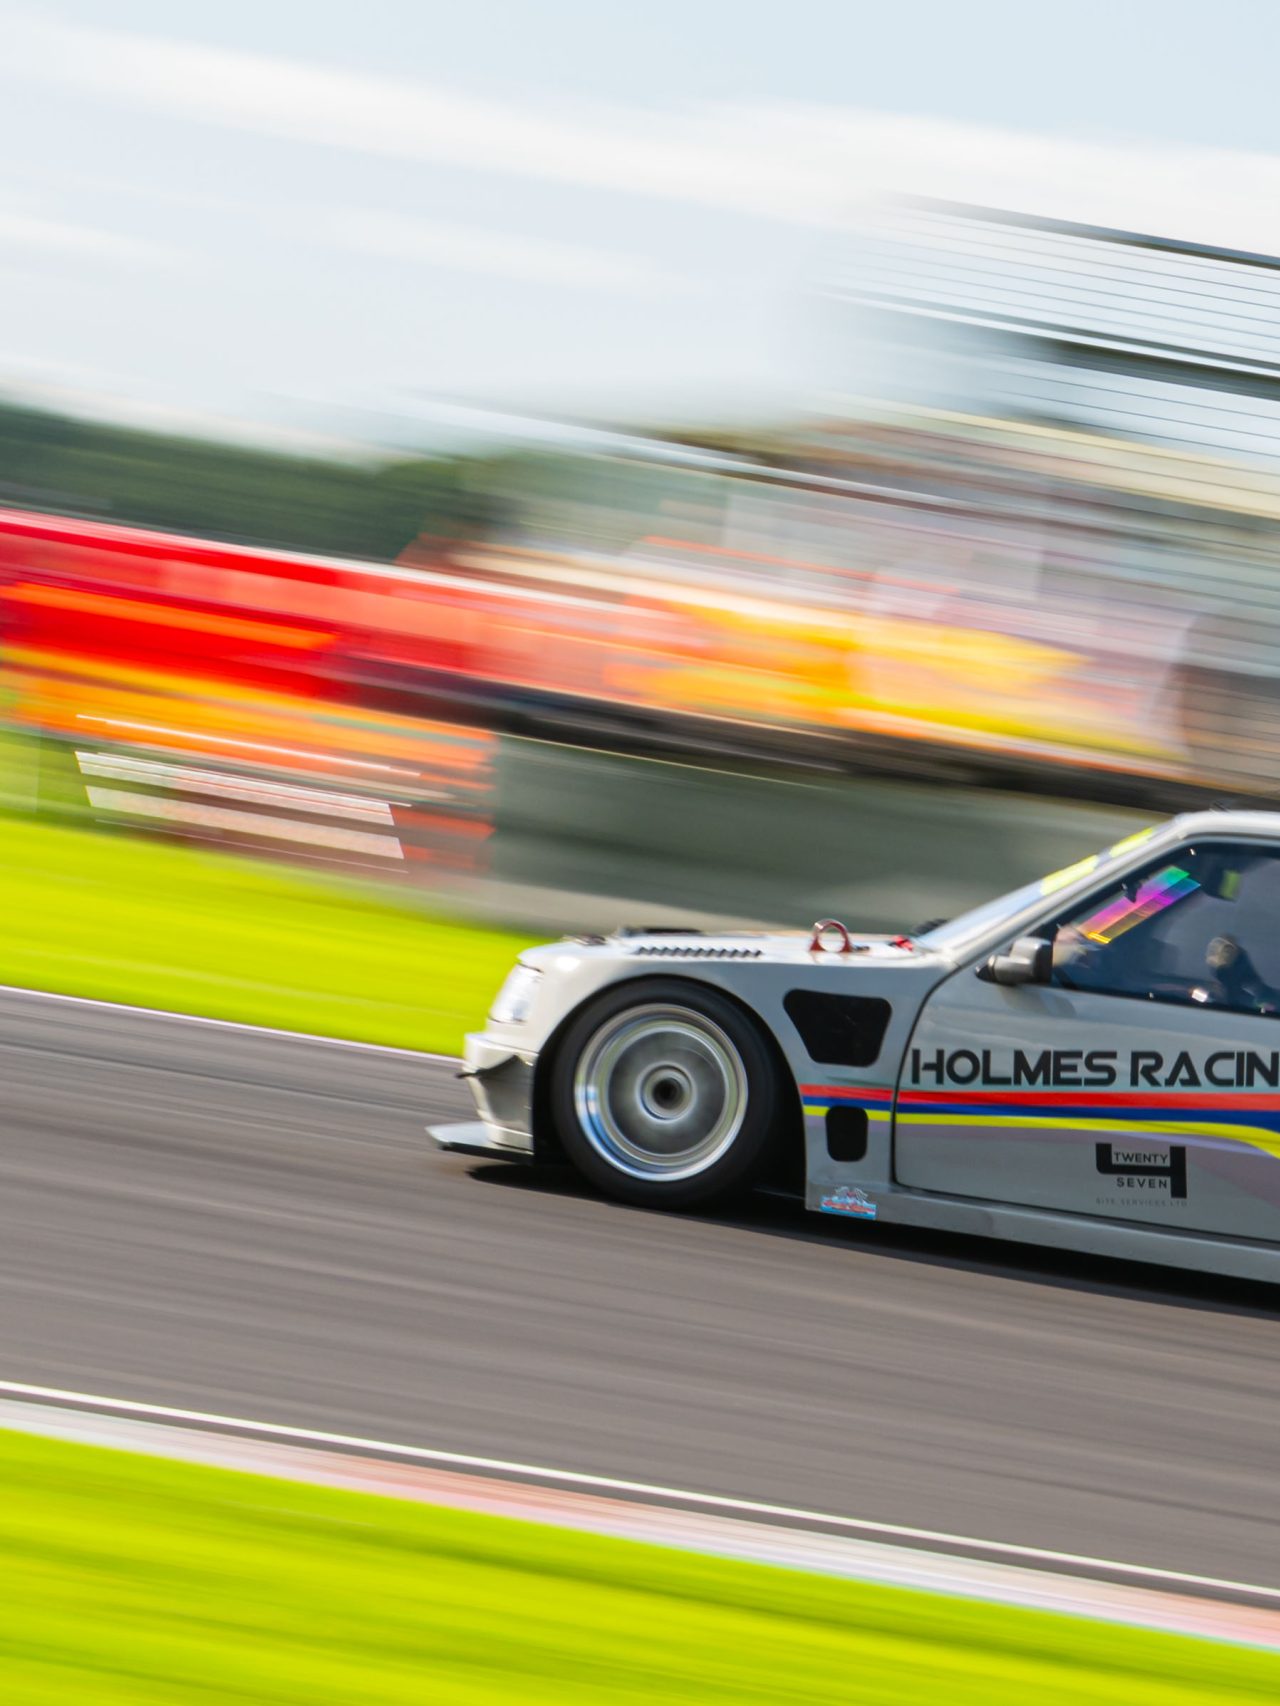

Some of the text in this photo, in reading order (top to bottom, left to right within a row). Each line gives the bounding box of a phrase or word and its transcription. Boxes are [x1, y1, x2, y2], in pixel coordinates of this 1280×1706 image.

[911, 1048, 1117, 1086] HOLMES
[1114, 1152, 1168, 1164] TWENTY
[1116, 1177, 1167, 1189] SEVEN
